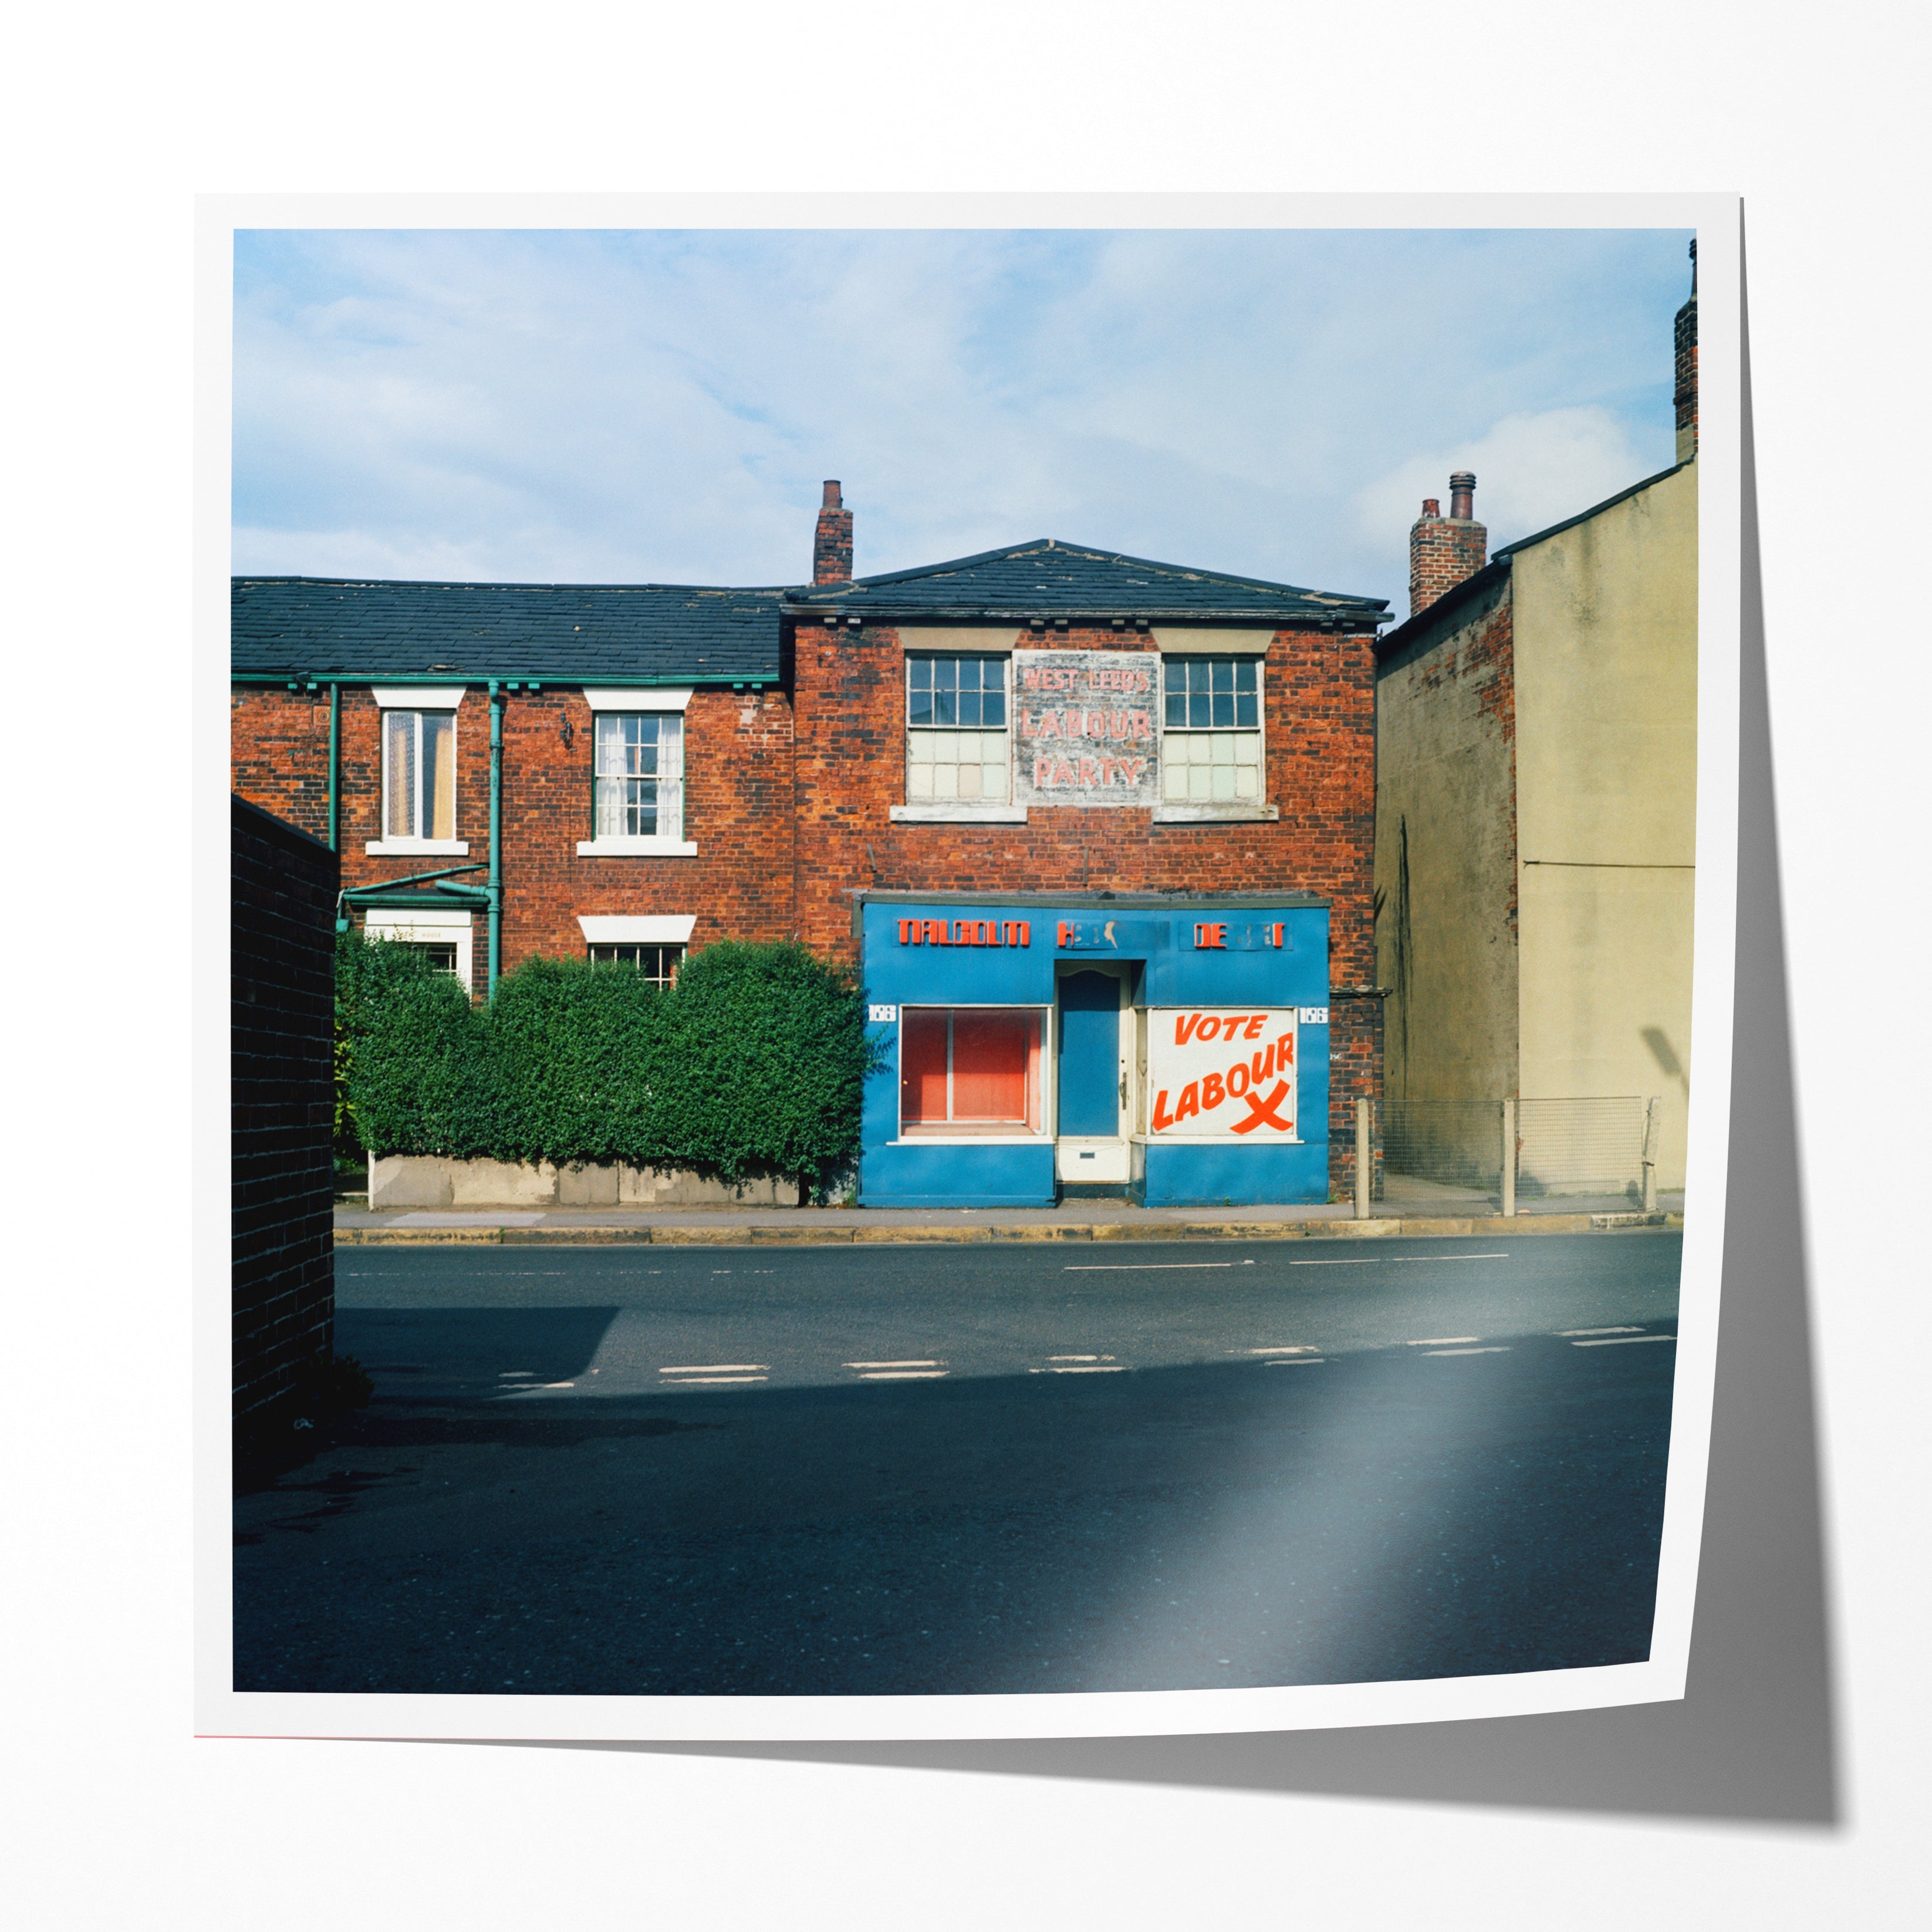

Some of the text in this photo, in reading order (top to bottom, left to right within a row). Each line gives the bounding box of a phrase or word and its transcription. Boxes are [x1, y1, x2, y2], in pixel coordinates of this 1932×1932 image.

[1025, 668, 1148, 692] WEST LEEDS
[1021, 710, 1151, 738] LABOUR
[1035, 756, 1142, 786] PARTY
[898, 919, 1030, 945] MALCOLM
[869, 1004, 897, 1022] 186
[1299, 1007, 1328, 1024] 186
[1175, 1014, 1268, 1045] VOTE
[1152, 1032, 1293, 1131] LABOUR
